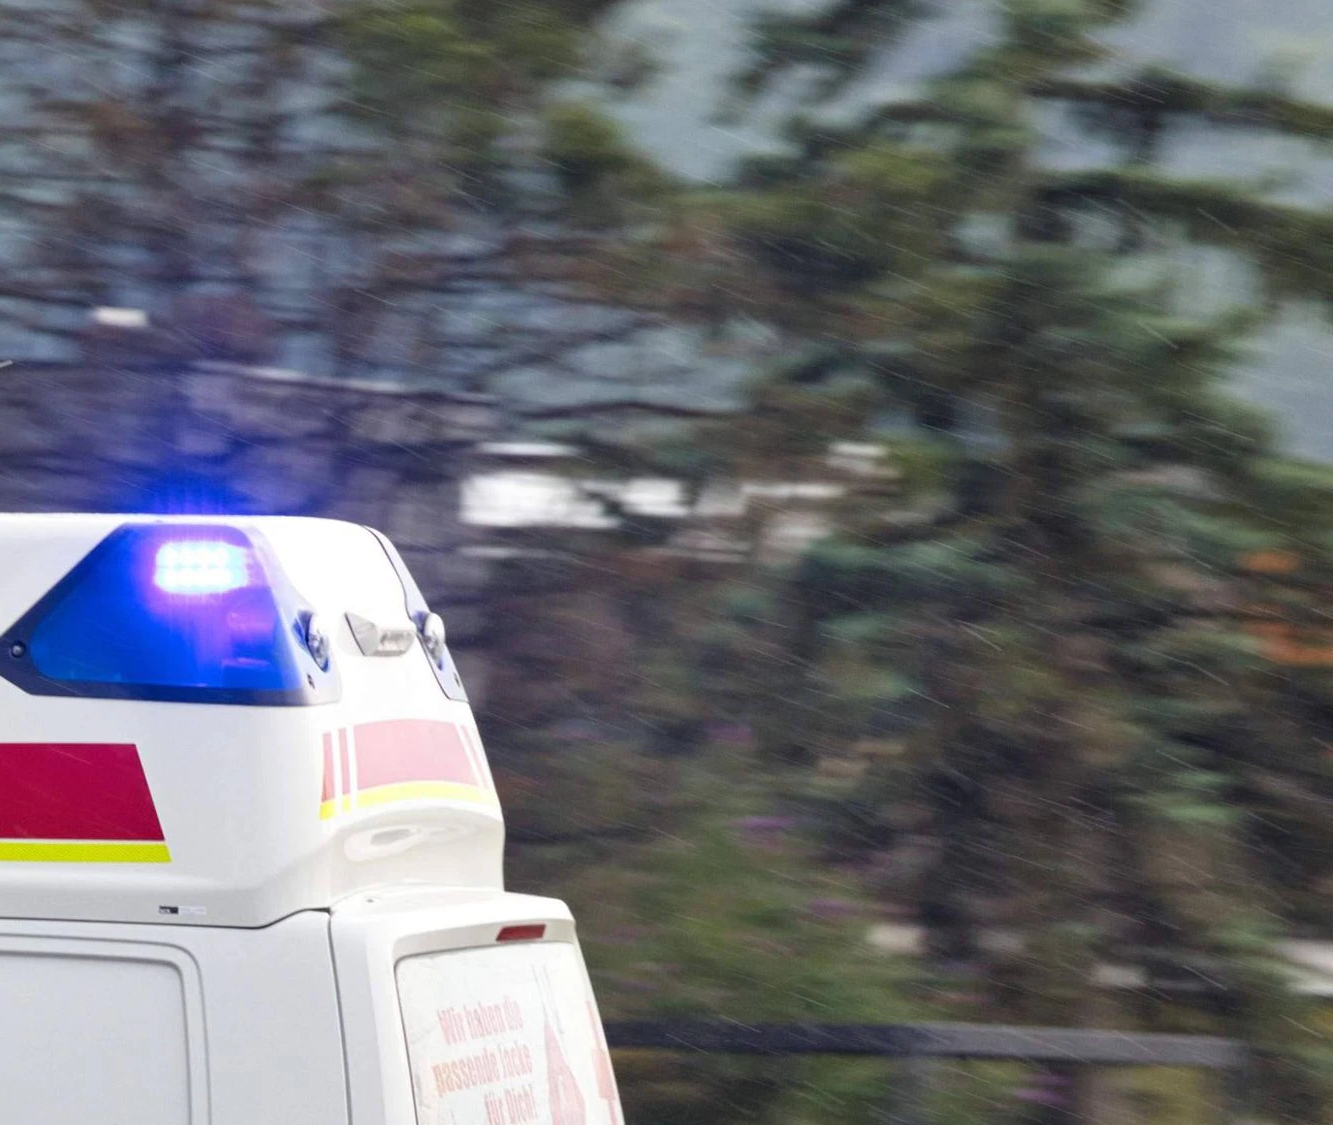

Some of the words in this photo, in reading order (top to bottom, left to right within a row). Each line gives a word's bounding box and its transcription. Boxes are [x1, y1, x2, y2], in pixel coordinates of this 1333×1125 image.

[437, 1007, 467, 1045] Wir
[463, 1001, 506, 1040] haben
[432, 1046, 500, 1098] passende
